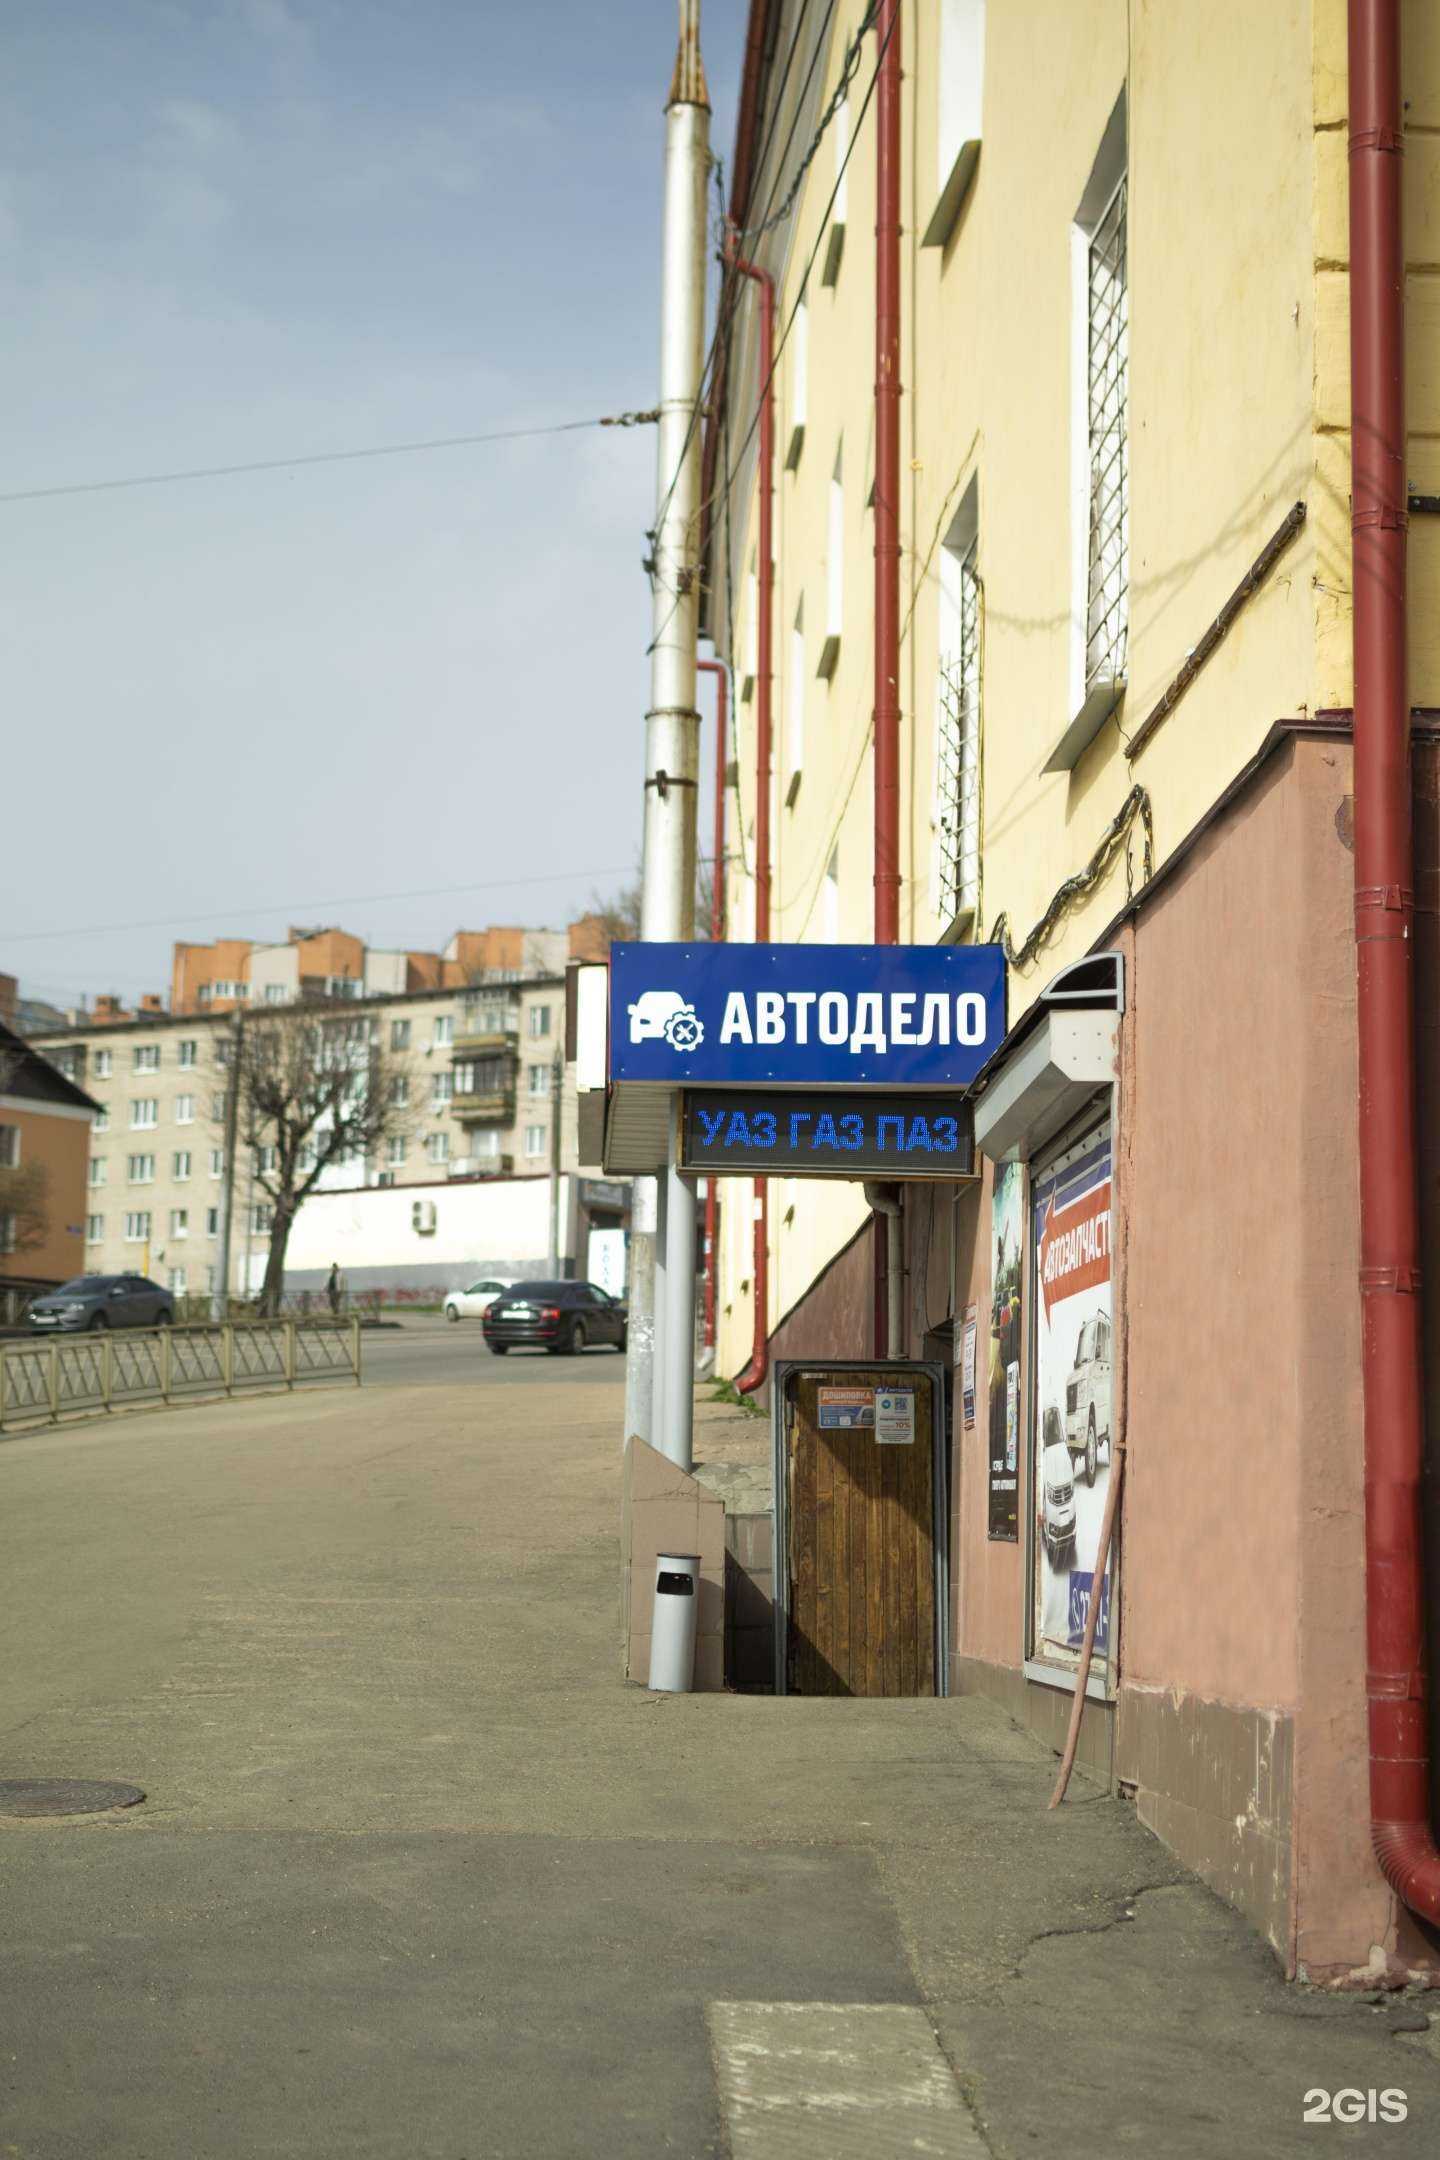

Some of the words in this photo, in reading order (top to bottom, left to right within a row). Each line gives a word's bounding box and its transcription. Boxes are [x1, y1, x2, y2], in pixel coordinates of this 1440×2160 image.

[719, 991, 987, 1054] АВТОДЕЛО
[696, 1110, 777, 1148] УАЗ
[790, 1111, 864, 1150] ГАЗ
[875, 1114, 958, 1153] ПАЗ
